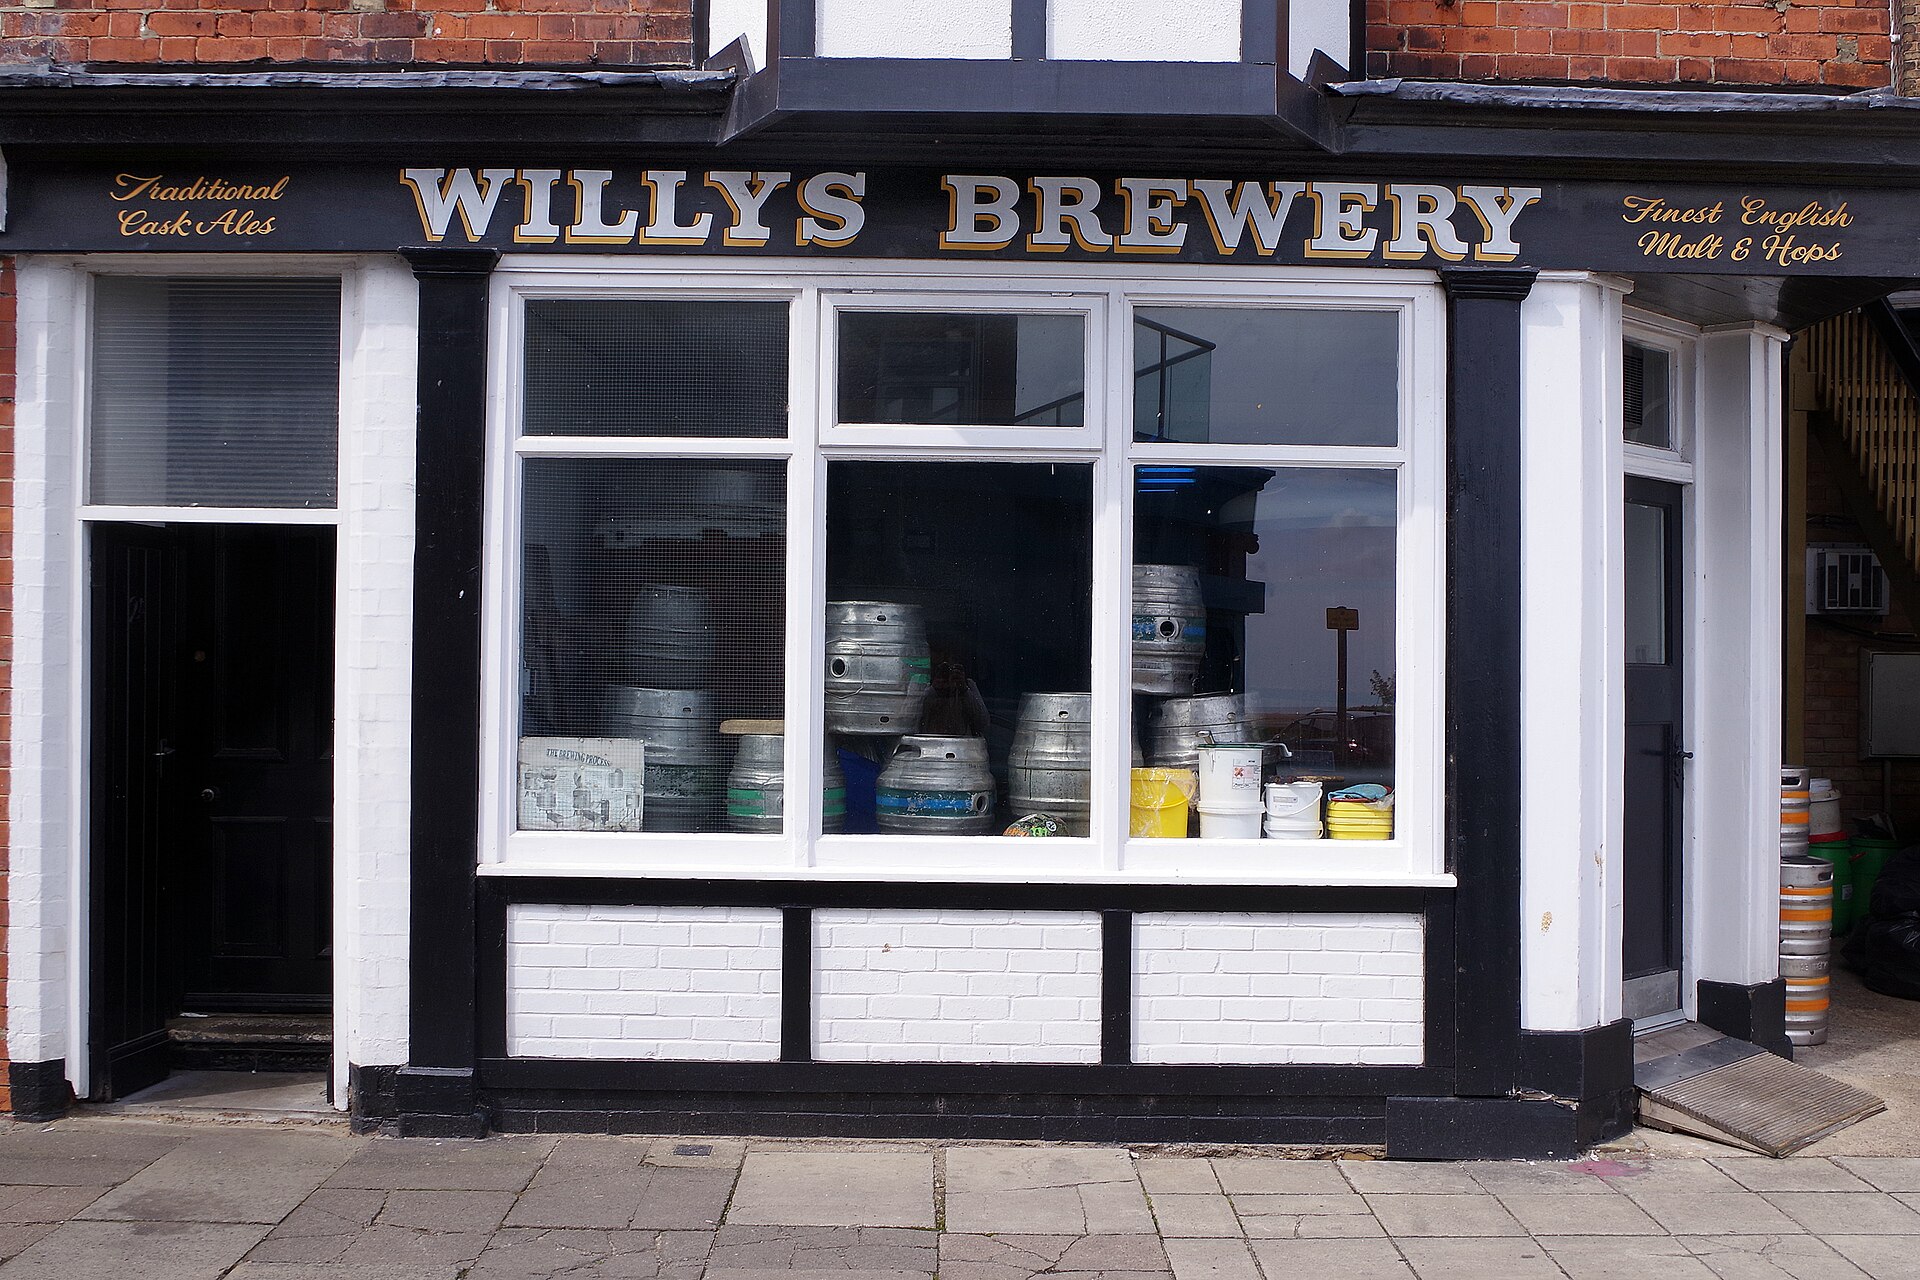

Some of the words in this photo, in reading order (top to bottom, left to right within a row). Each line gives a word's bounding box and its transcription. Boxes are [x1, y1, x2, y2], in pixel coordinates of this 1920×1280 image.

[109, 173, 290, 201] Traditional
[117, 209, 192, 237] Cask
[195, 208, 276, 236] Ales
[399, 167, 866, 248] WILLYS
[939, 174, 1542, 264] BREWERY
[1622, 195, 1724, 223] Finest
[1740, 195, 1854, 234] English
[1637, 230, 1724, 260] Malt
[1730, 237, 1753, 262] &
[1761, 234, 1843, 267] Hops
[546, 748, 559, 758] THE
[559, 749, 586, 763] BREWING
[585, 753, 611, 767] PROCESS
